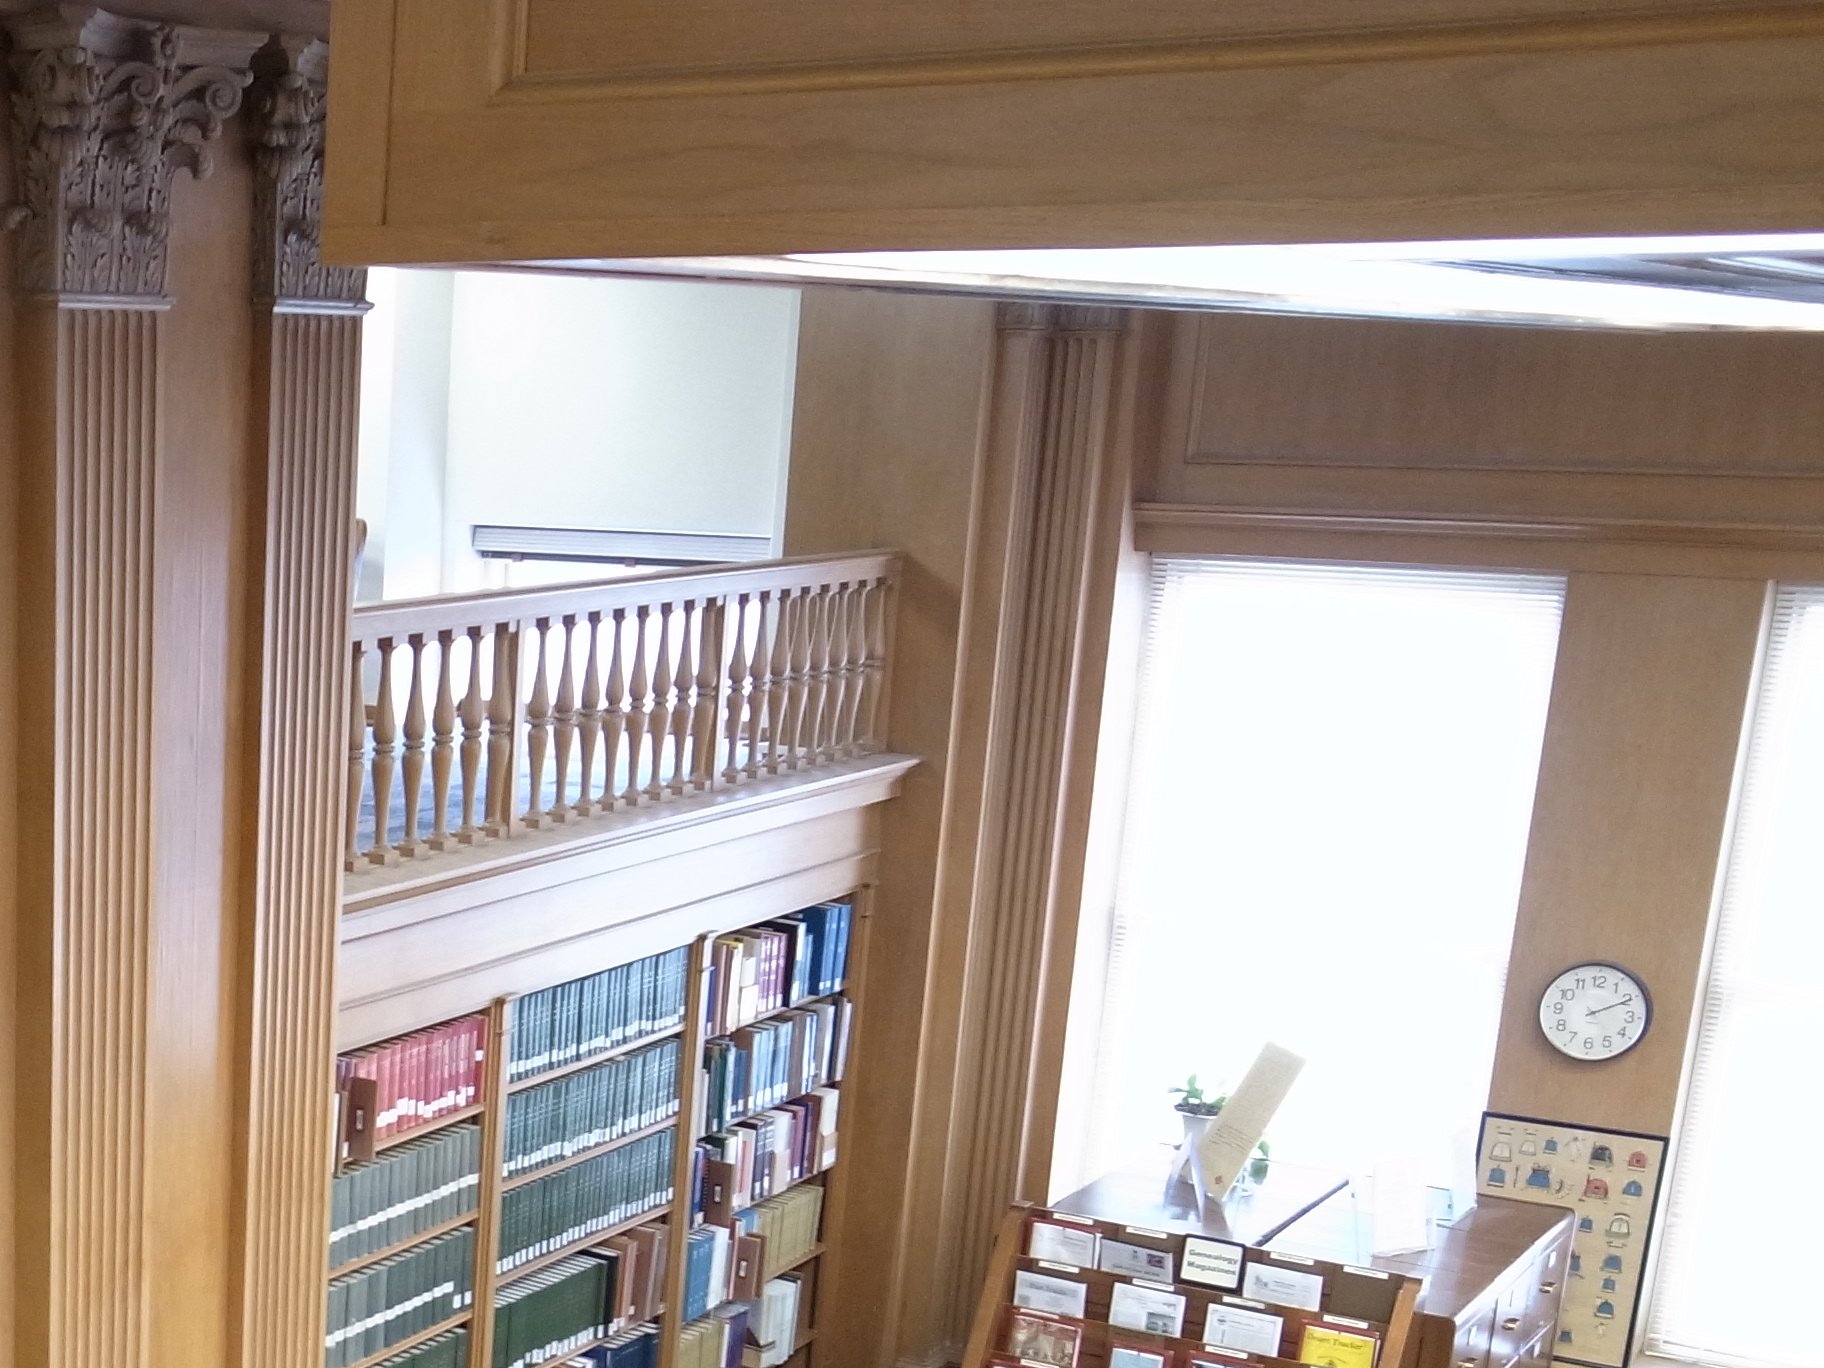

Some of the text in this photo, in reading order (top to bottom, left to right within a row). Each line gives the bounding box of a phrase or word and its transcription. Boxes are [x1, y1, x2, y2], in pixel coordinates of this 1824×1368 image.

[1574, 977, 1586, 990] 11
[1591, 975, 1607, 989] 12
[1612, 981, 1619, 994] 1
[1559, 988, 1575, 1001] 10
[1552, 1001, 1564, 1015] 9
[1623, 1010, 1635, 1024] 3
[1555, 1018, 1567, 1032] 8
[1568, 1030, 1578, 1043] 7
[1616, 1026, 1627, 1039] 4
[1583, 1036, 1594, 1050] 6
[1601, 1035, 1613, 1049] 5
[1188, 1248, 1238, 1266] Genealogy
